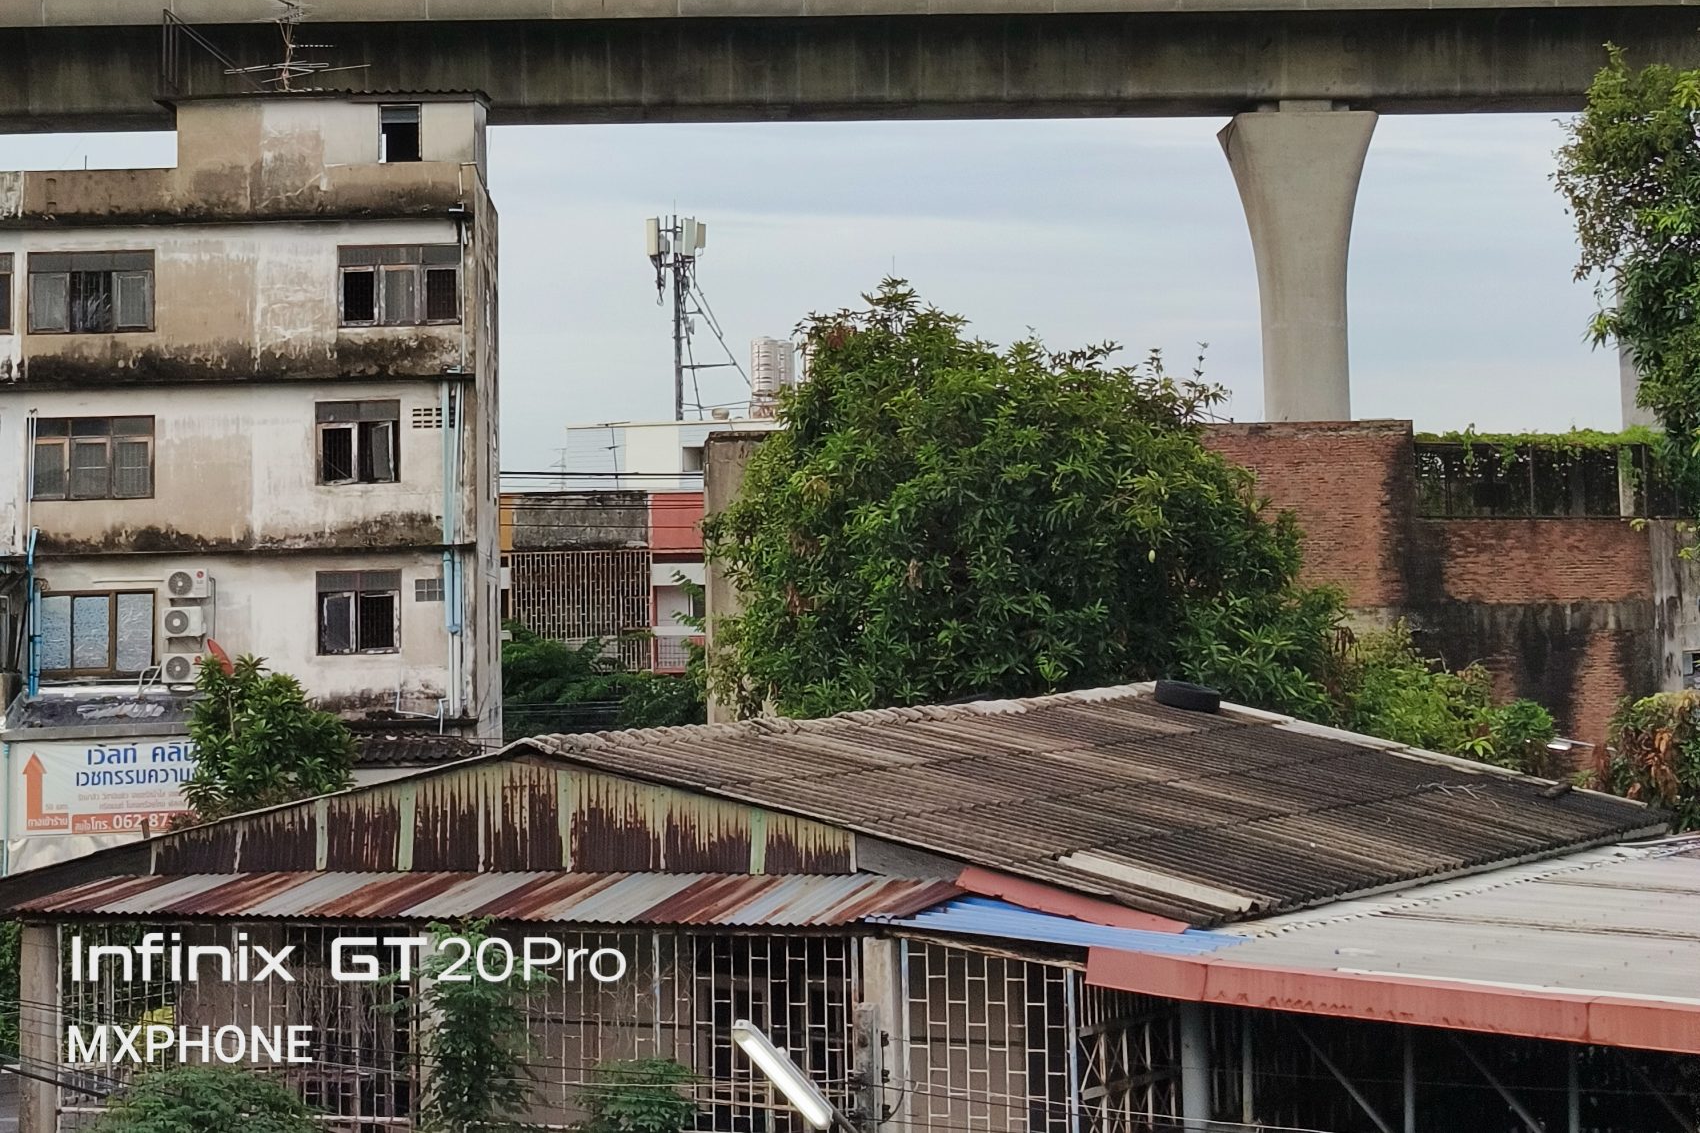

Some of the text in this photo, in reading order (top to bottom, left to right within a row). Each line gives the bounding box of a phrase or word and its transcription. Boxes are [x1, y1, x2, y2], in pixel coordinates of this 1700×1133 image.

[76, 768, 195, 787] เวชกรรมความ
